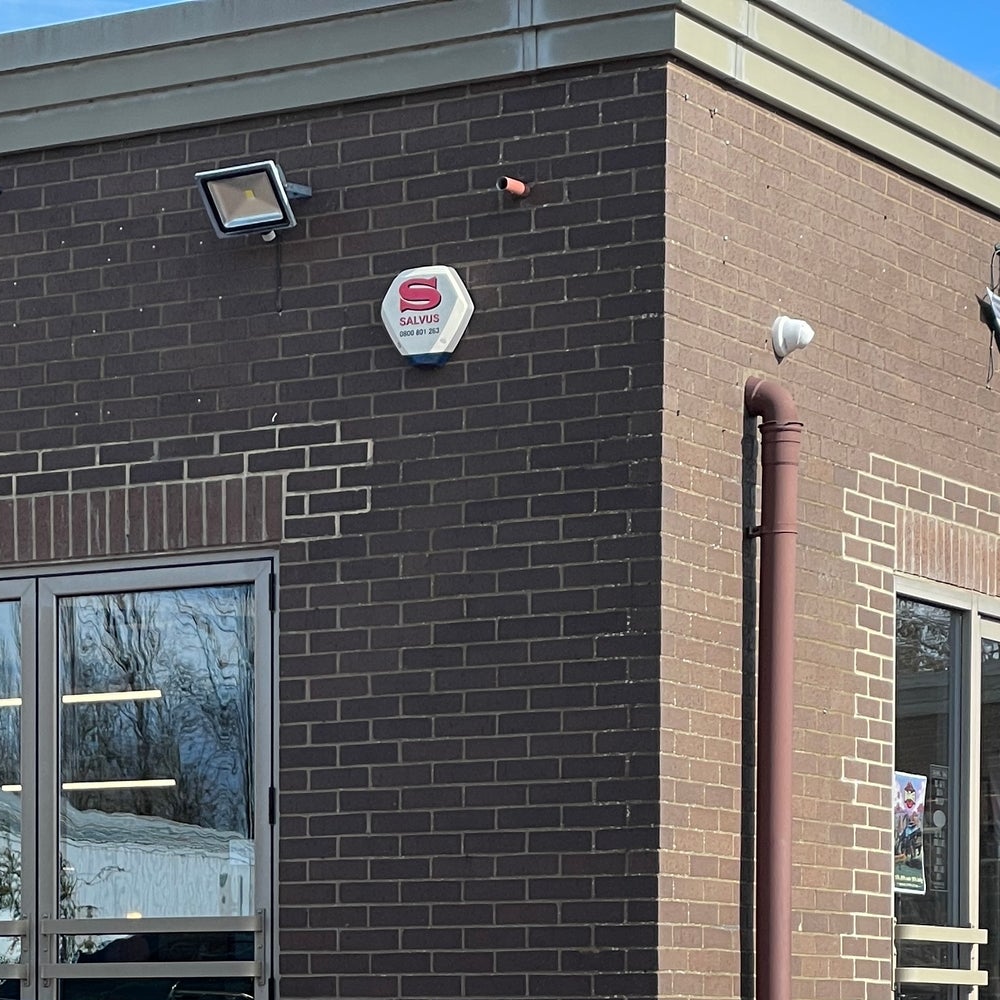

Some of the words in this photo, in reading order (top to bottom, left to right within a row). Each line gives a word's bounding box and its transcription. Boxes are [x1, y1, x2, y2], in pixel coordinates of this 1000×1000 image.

[399, 276, 442, 313] S
[400, 314, 440, 326] SALVUS
[399, 330, 415, 338] 0800
